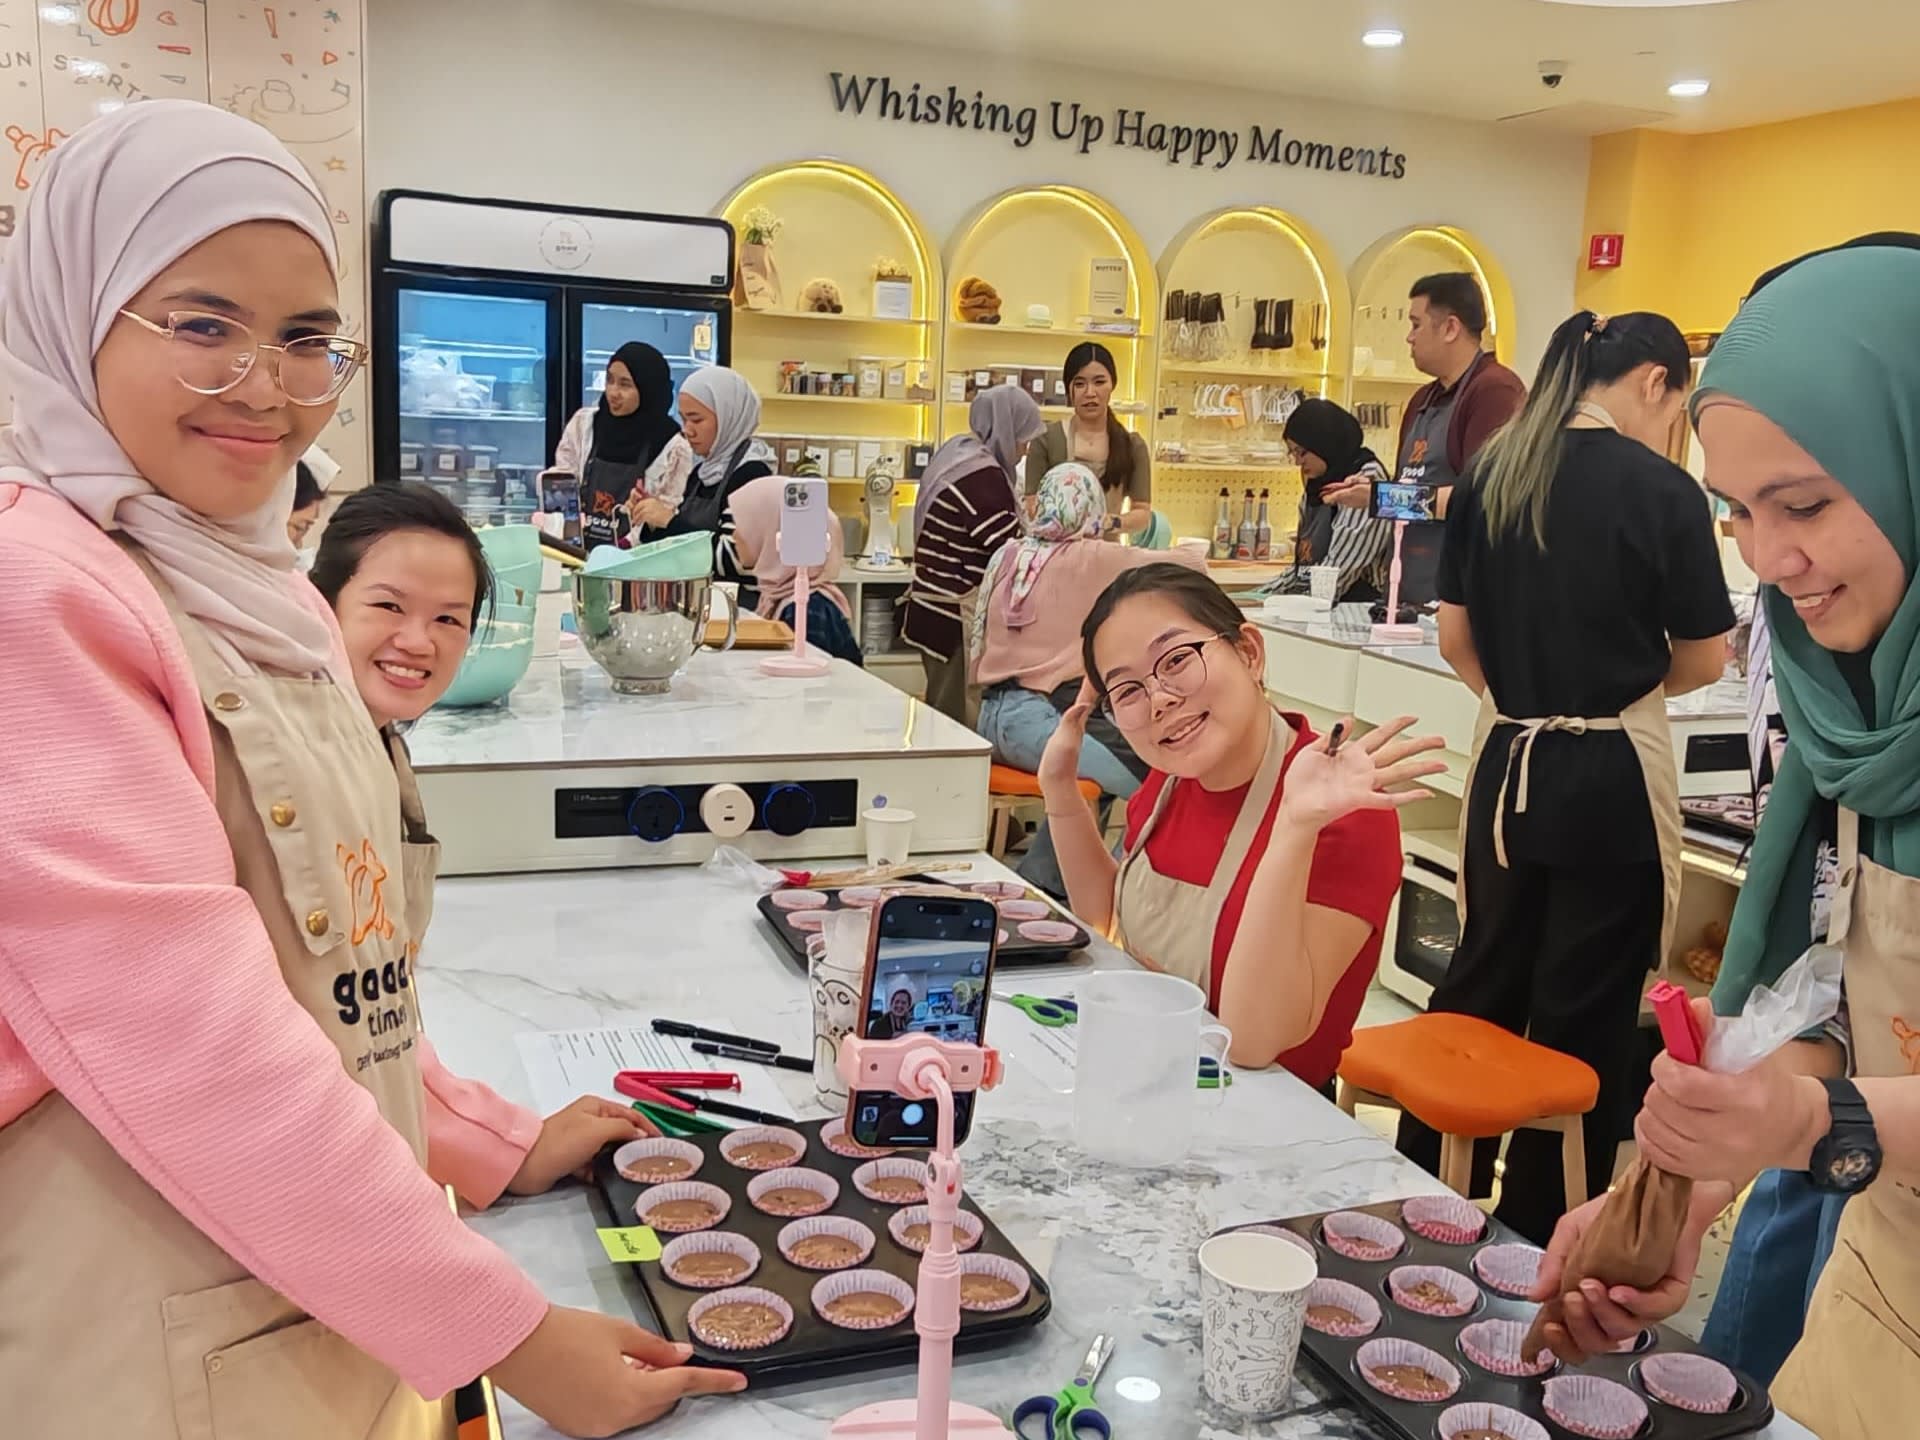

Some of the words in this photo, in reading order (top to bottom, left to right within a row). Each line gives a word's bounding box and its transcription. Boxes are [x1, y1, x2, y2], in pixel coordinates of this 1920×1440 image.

[829, 71, 1038, 149] Whisking
[1050, 101, 1105, 154] Up
[1114, 108, 1240, 170] Happy
[1247, 125, 1407, 179] Moments
